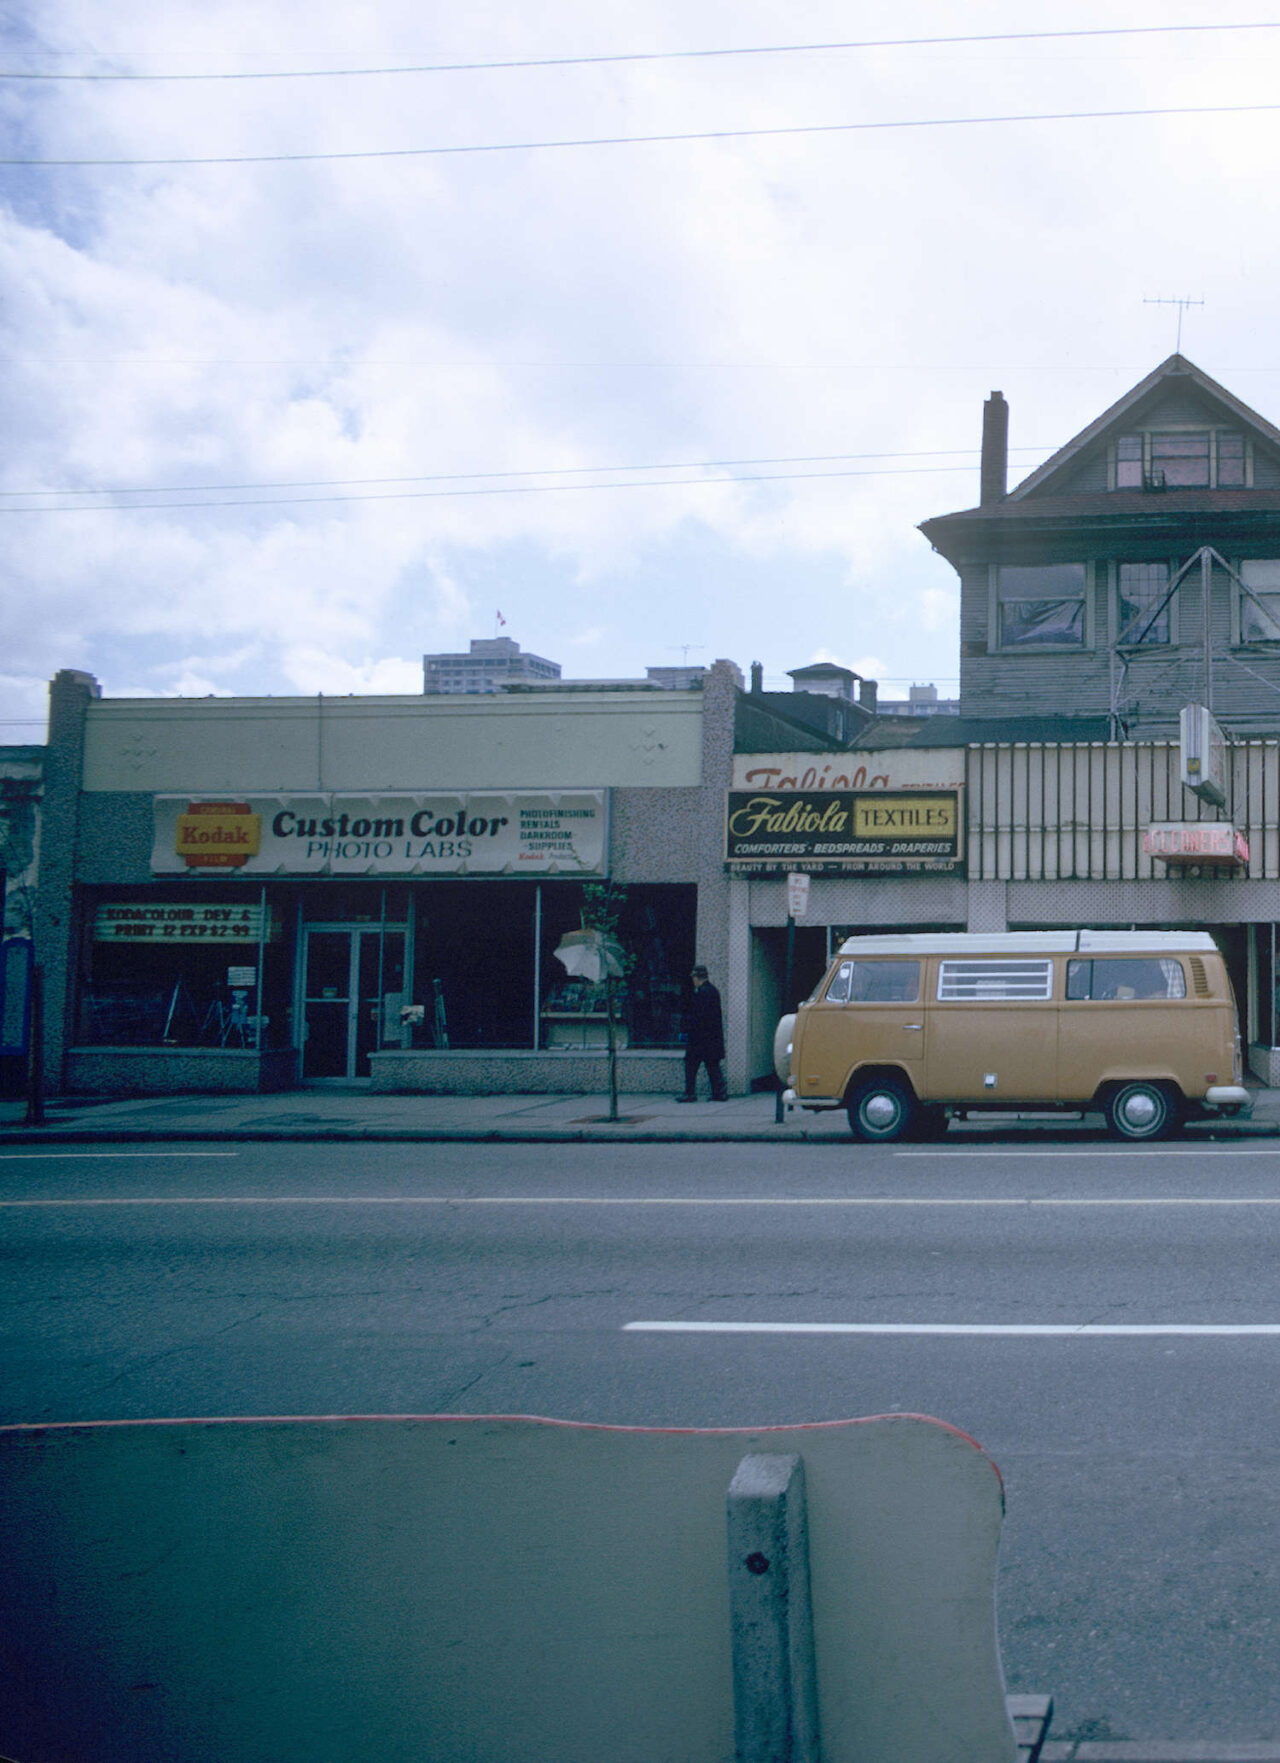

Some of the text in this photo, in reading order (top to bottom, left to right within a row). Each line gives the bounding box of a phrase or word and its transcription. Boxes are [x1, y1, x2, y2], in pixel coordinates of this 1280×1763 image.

[519, 809, 596, 819] PHOTOFINISHING
[728, 797, 949, 838] Fabiola TEXTILES
[271, 809, 510, 838] Custom Color
[519, 820, 561, 829] RENTALS
[181, 825, 250, 845] Kodak
[519, 831, 573, 841] DARKROOM
[1151, 829, 1231, 853] CLEANERS
[306, 840, 473, 859] PHOTO LABS
[528, 842, 574, 851] SUPPLIES
[734, 841, 953, 854] COMFORTERS BEDSPREADS DRAPERIES
[730, 863, 763, 872] BEAUTY
[799, 863, 824, 871] YARD
[841, 863, 865, 871] FROM
[867, 863, 902, 871] AROUND
[905, 862, 922, 871] THE
[923, 862, 955, 871] WORLD
[106, 908, 194, 921] KODACOLOUR
[203, 908, 233, 921] DEV
[114, 924, 156, 937] PRINT
[163, 924, 177, 936] 12
[180, 924, 207, 936] EXP
